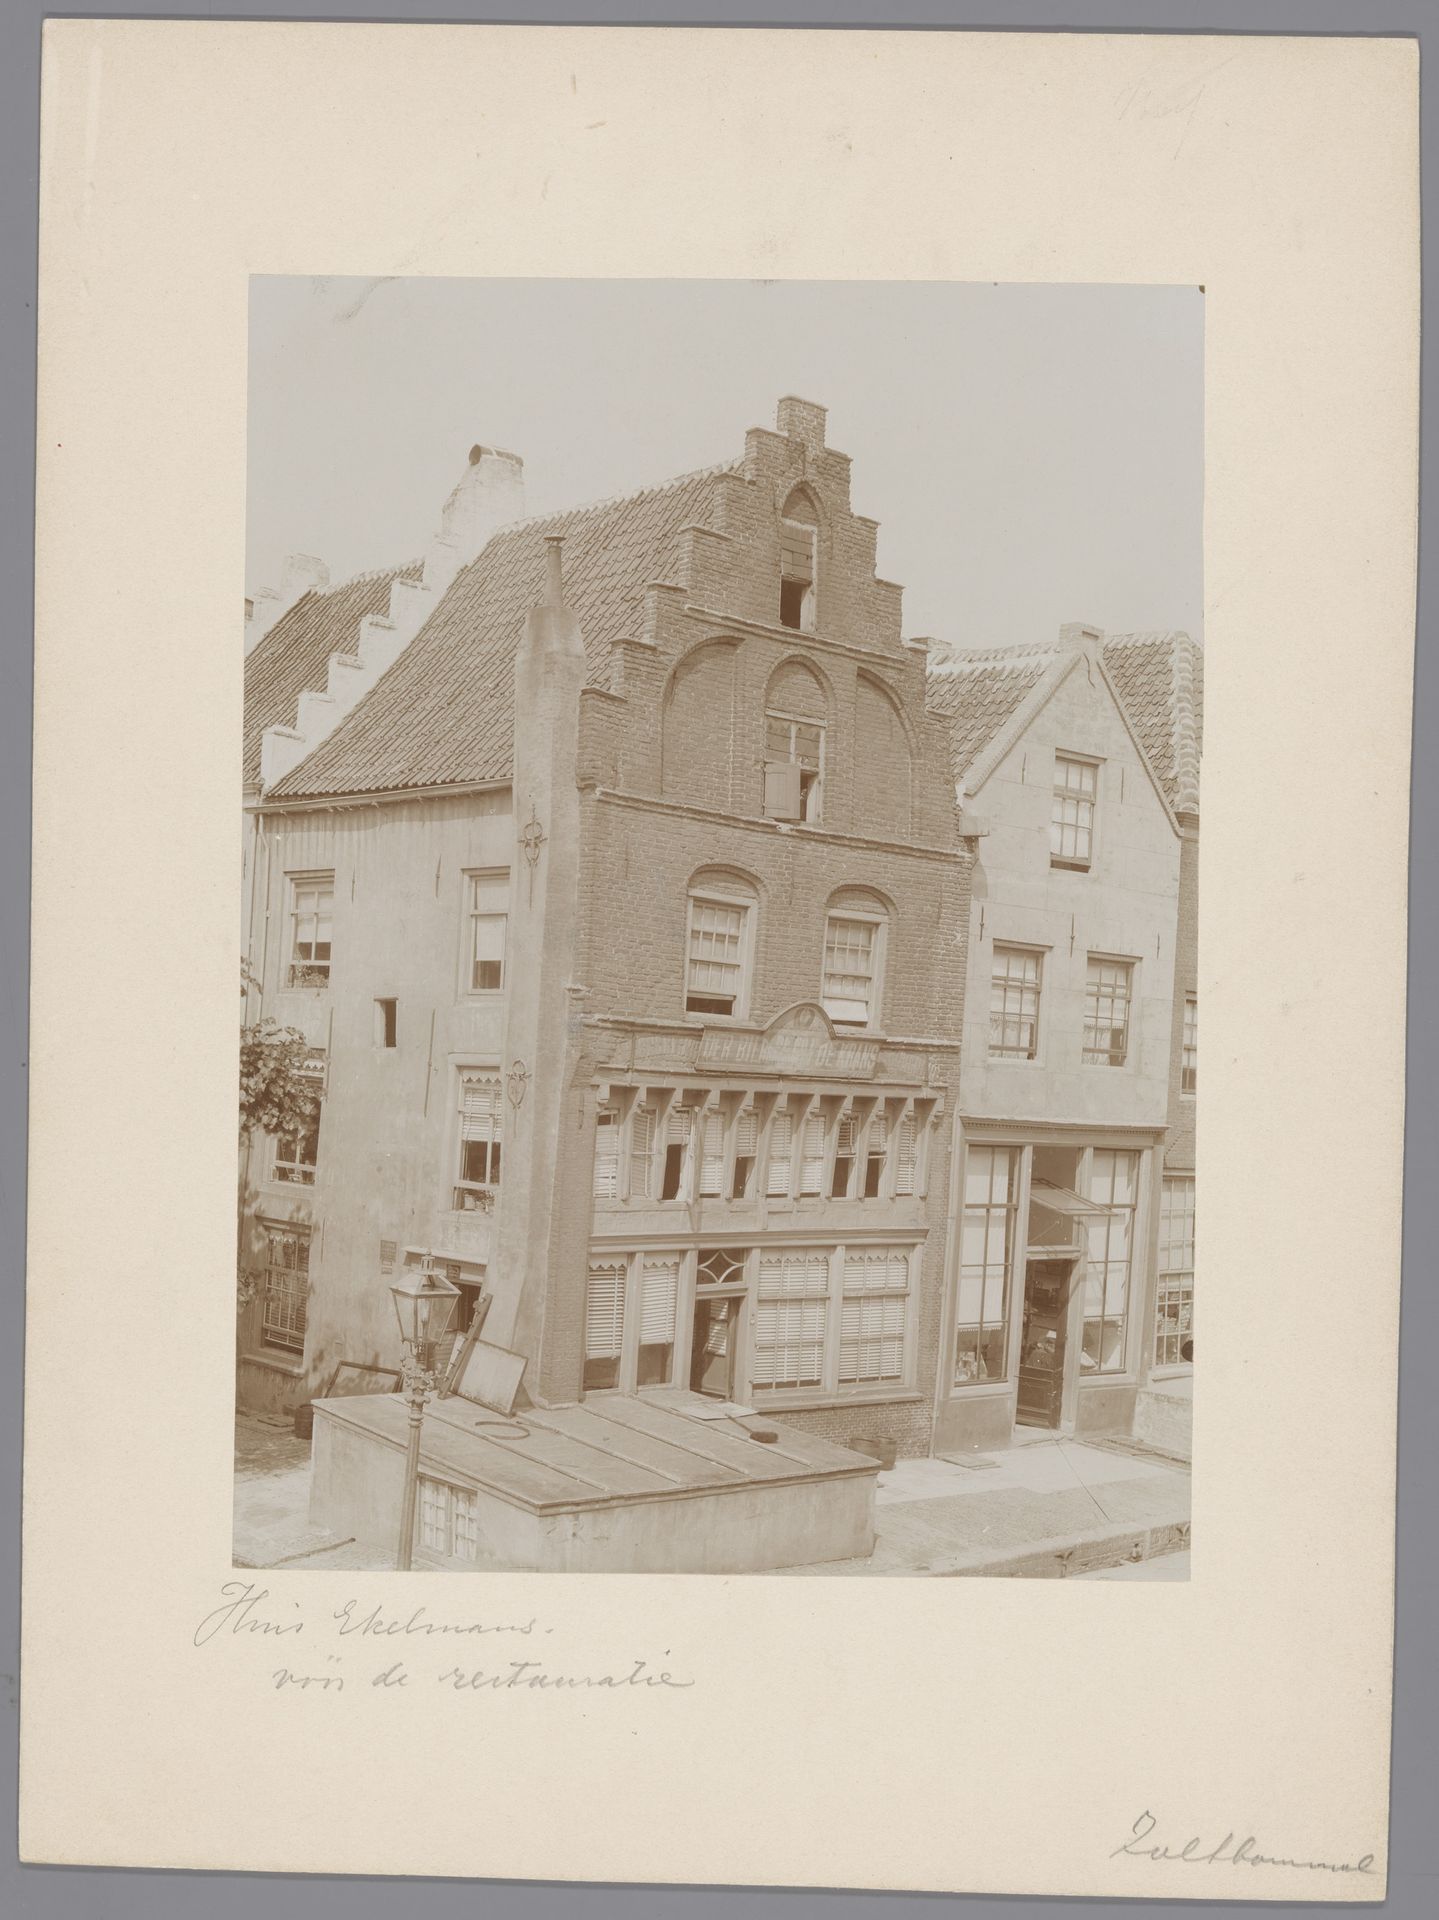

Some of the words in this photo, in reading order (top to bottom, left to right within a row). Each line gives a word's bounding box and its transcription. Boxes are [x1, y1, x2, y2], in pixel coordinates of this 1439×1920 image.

[193, 1582, 304, 1647] Huis
[371, 1662, 409, 1688] de
[438, 1649, 696, 1690] restauratie
